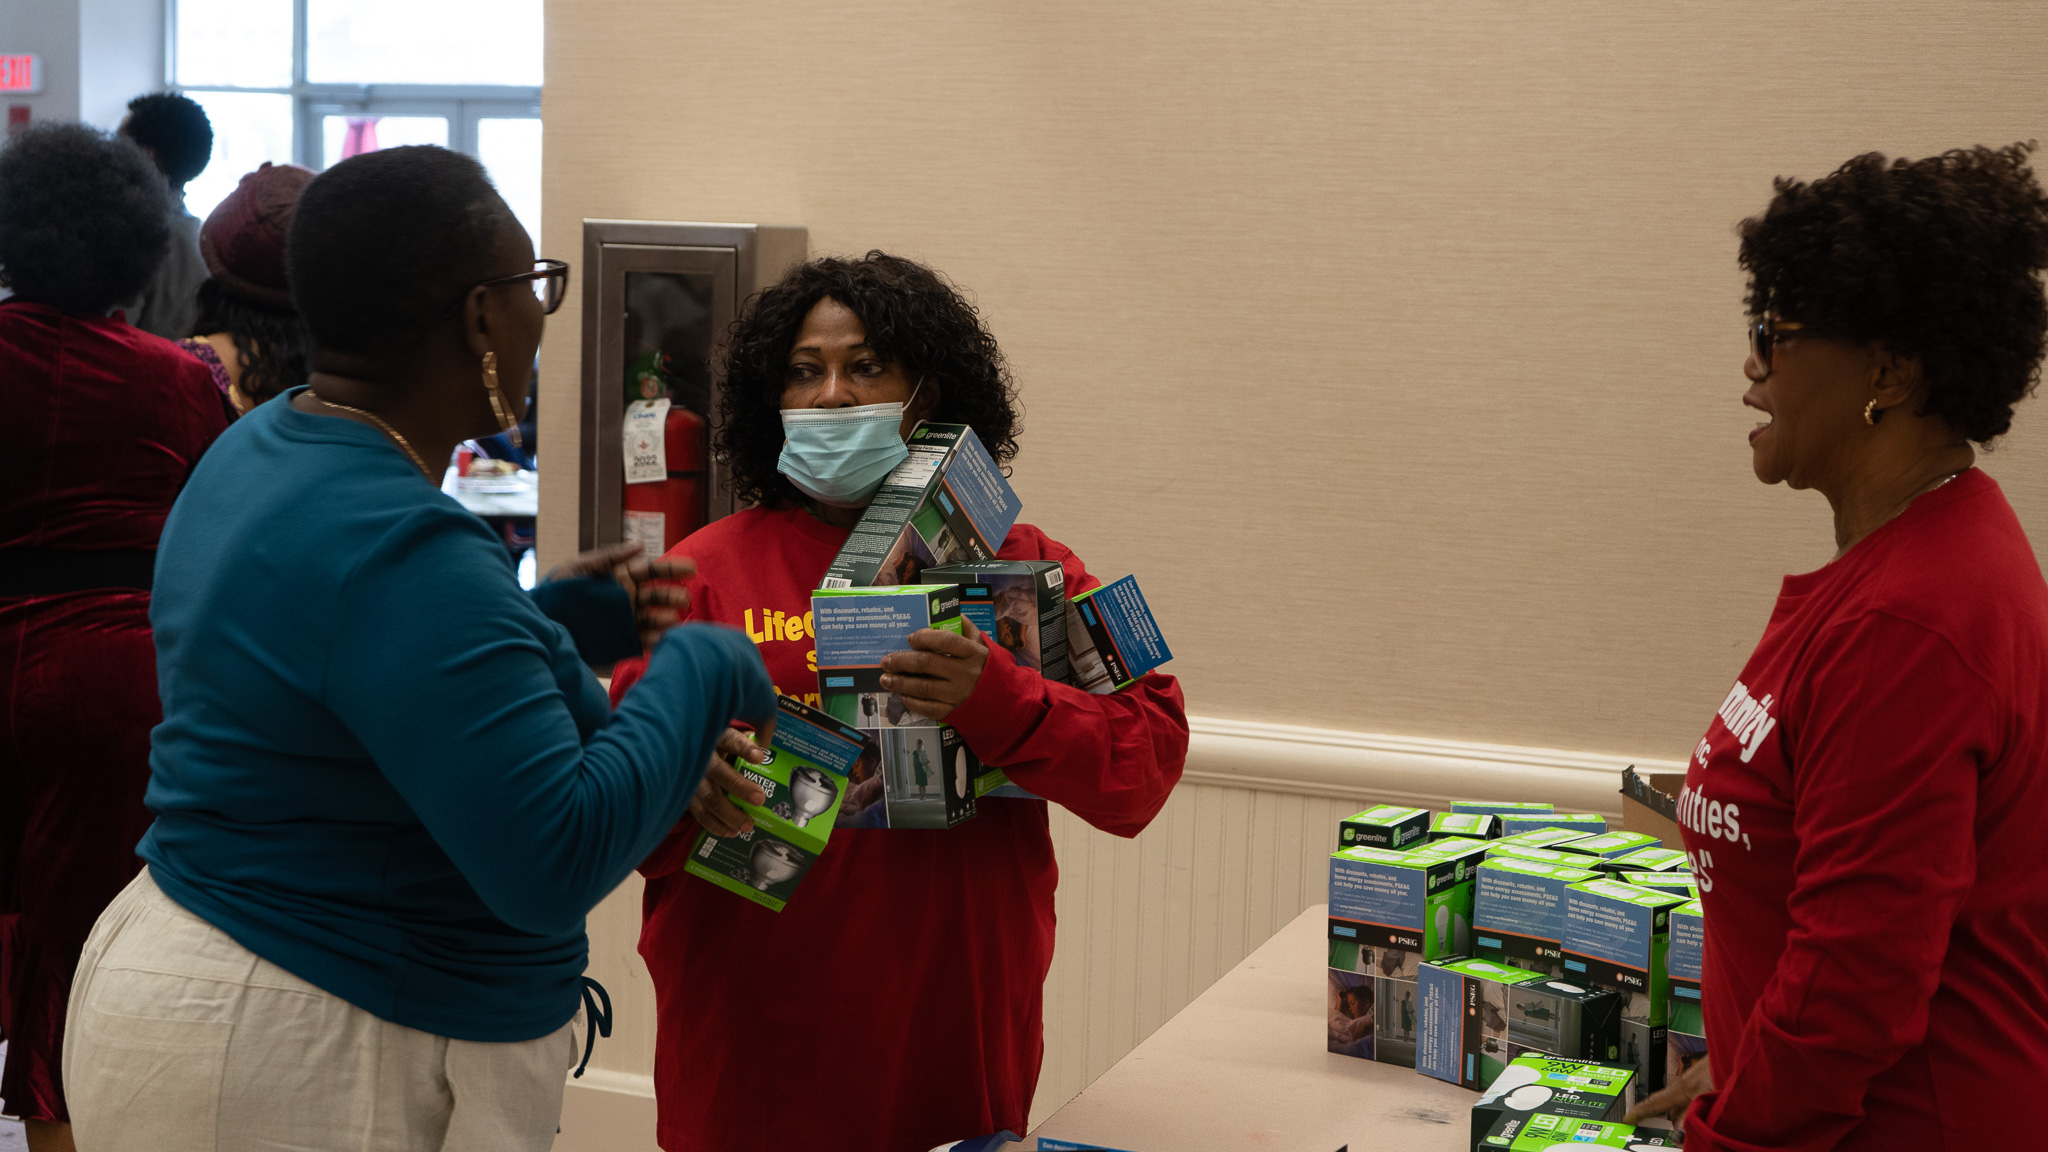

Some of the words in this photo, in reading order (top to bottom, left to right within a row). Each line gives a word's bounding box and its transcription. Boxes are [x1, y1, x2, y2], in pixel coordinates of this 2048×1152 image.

[0, 55, 32, 90] EXIT
[925, 432, 957, 440] greenlite
[633, 454, 658, 467] 2022
[941, 597, 959, 613] greenlite
[942, 728, 955, 740] LED
[743, 769, 777, 791] WATER
[1356, 833, 1387, 843] greenlite
[1401, 825, 1420, 844] greenlite
[1436, 872, 1454, 886] greenlite
[1398, 937, 1418, 946] PSEG
[1624, 976, 1643, 986] PSEG
[1469, 984, 1477, 1007] PSEG
[1653, 1030, 1666, 1039] LED
[1543, 1055, 1601, 1065] greenlite
[1582, 1066, 1628, 1077] LED
[1555, 1092, 1580, 1100] LED
[1531, 1114, 1560, 1130] LED
[1500, 1119, 1520, 1139] greenlite
